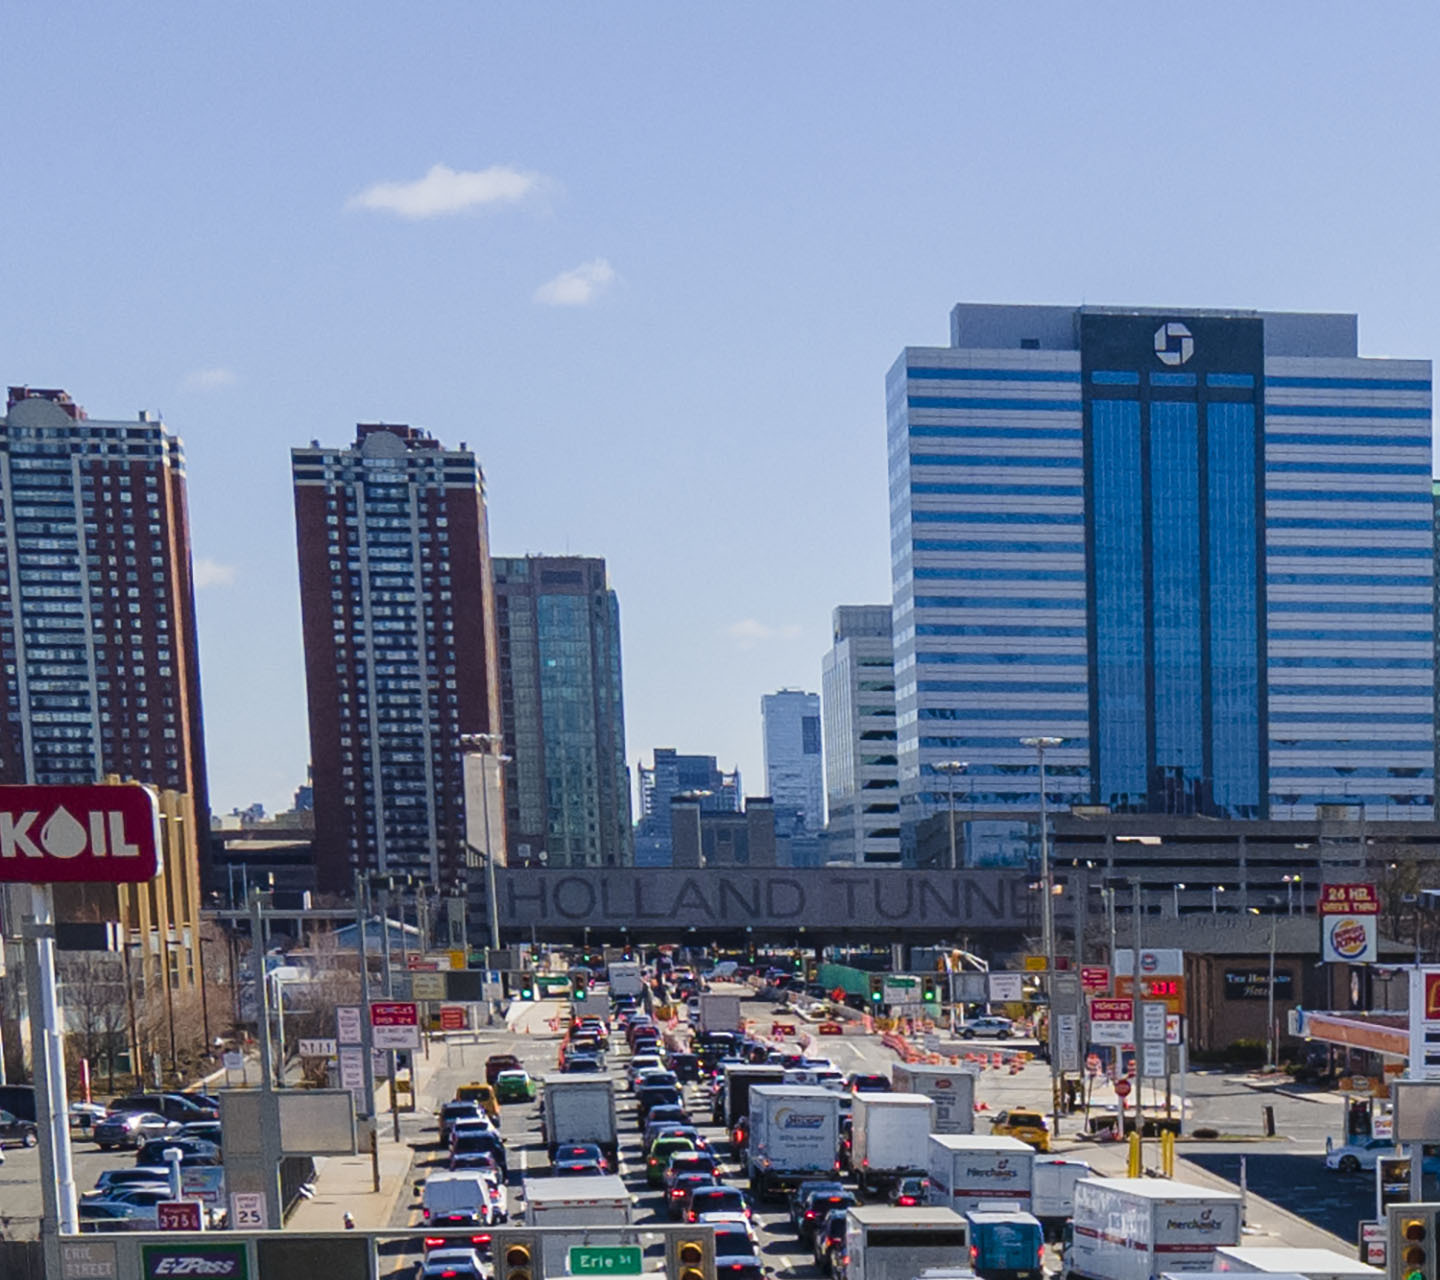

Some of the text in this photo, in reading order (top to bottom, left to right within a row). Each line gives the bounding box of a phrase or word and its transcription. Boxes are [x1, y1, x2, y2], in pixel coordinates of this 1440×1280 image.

[506, 876, 805, 921] HOLLAND
[238, 1210, 261, 1223] 25
[580, 1254, 613, 1268] Erie
